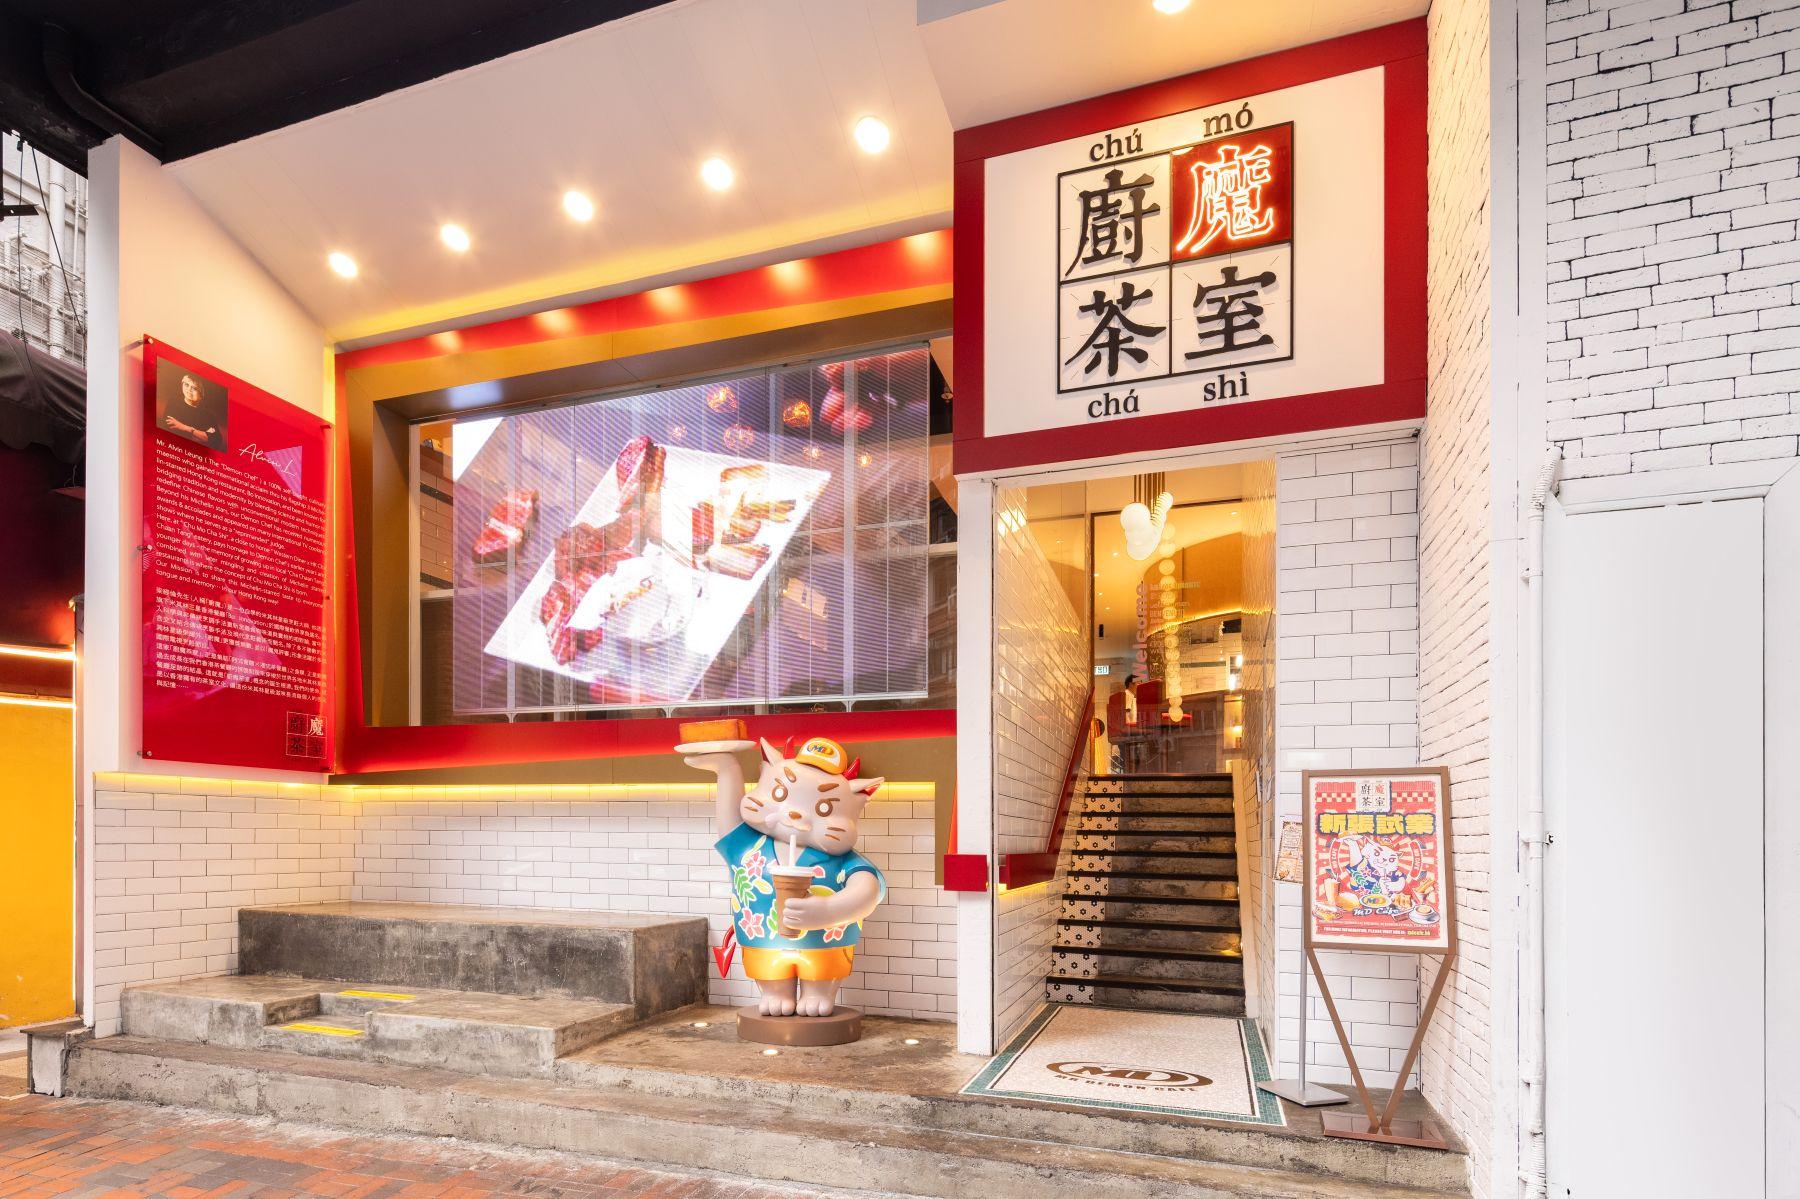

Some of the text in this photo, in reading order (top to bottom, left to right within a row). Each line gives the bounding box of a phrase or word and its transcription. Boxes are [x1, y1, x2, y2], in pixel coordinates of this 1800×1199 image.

[1089, 102, 1254, 163] chú mó
[1064, 265, 1277, 377] 茶室
[1203, 371, 1250, 403] shì
[1131, 582, 1148, 682] Welcome
[1086, 1080, 1146, 1090] DEMON
